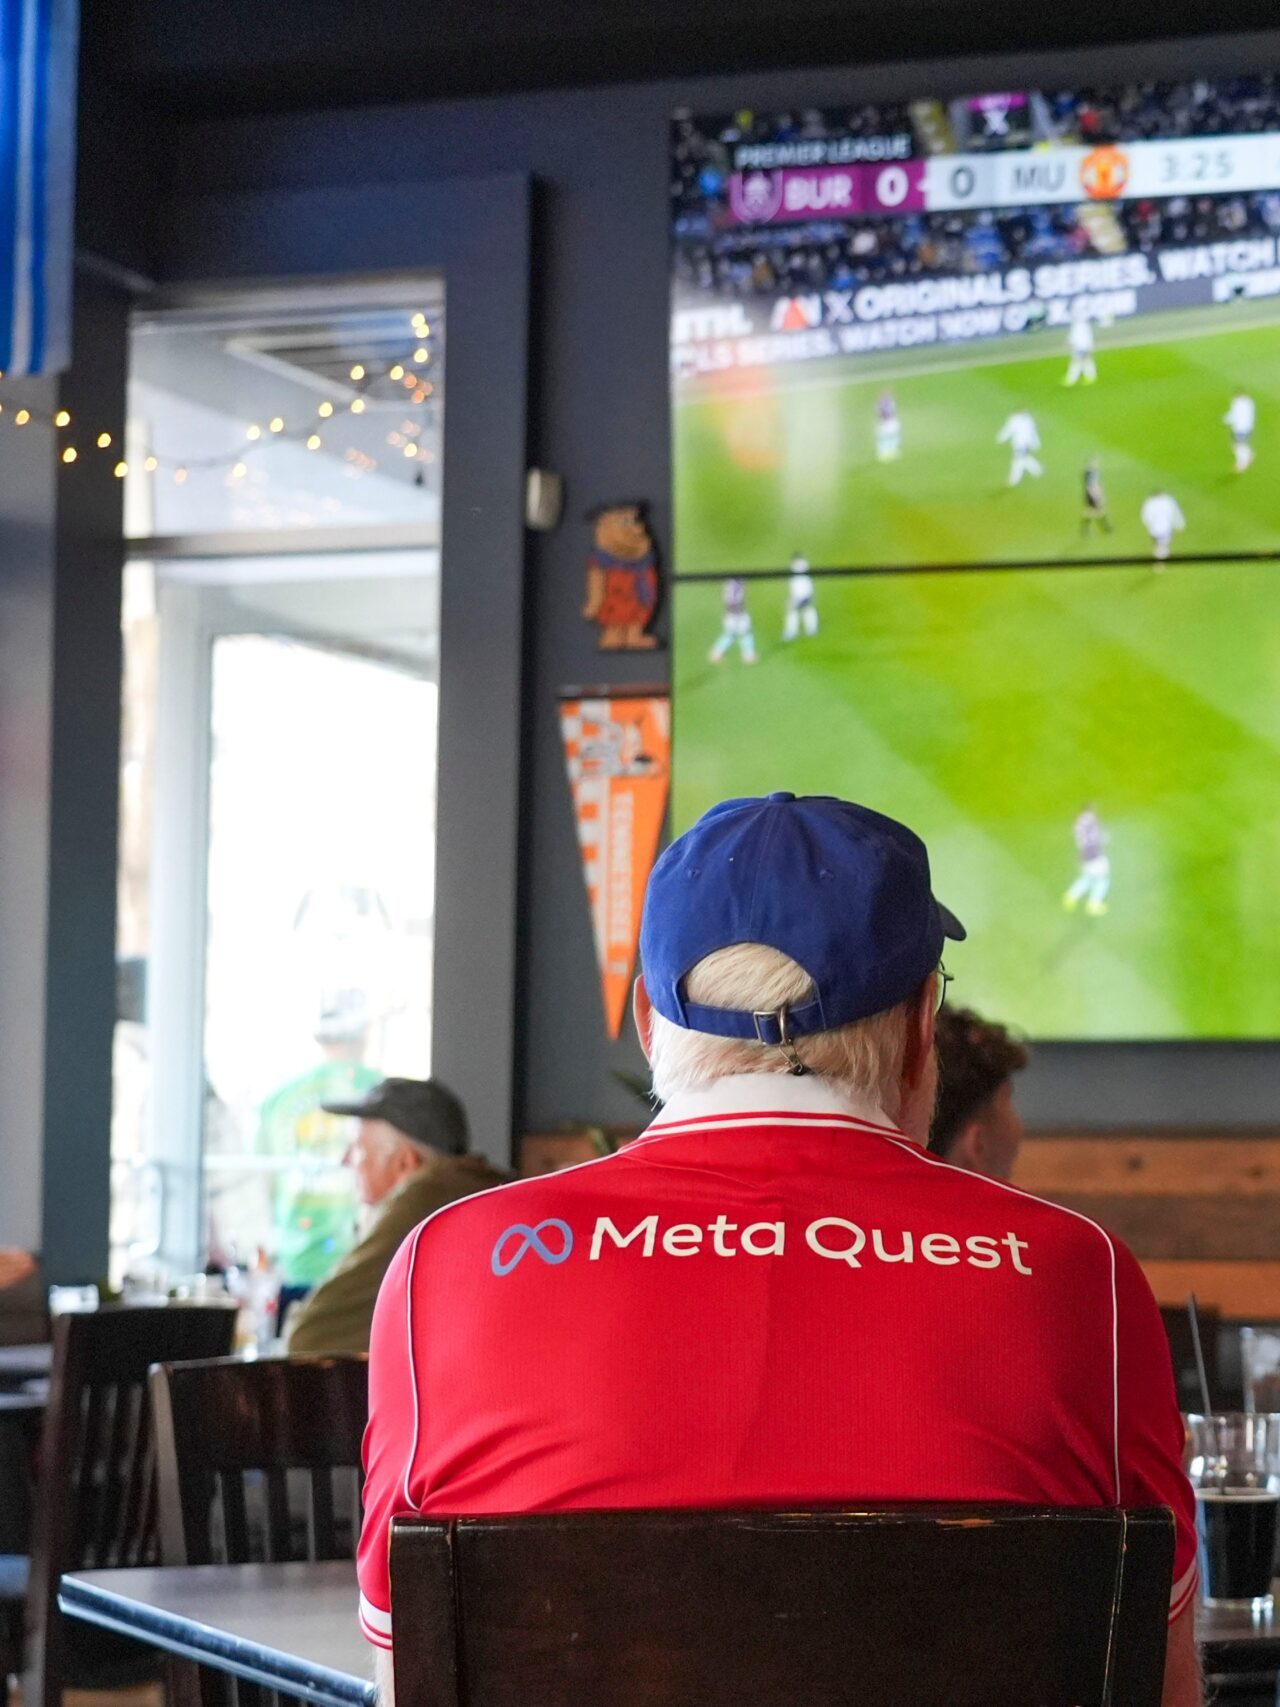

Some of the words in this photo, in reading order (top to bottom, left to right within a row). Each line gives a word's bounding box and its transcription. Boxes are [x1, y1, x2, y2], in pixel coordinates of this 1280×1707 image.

[734, 140, 827, 169] PREMIER
[827, 133, 911, 164] LEAGUE
[783, 173, 853, 212] BUR
[875, 165, 909, 207] 0
[950, 165, 975, 199] 0
[1013, 163, 1067, 194] MU
[854, 267, 1032, 321] ORIGINALS
[1157, 235, 1276, 283] WATCH
[588, 1214, 785, 1261] Meta
[805, 1216, 1033, 1276] Quest
